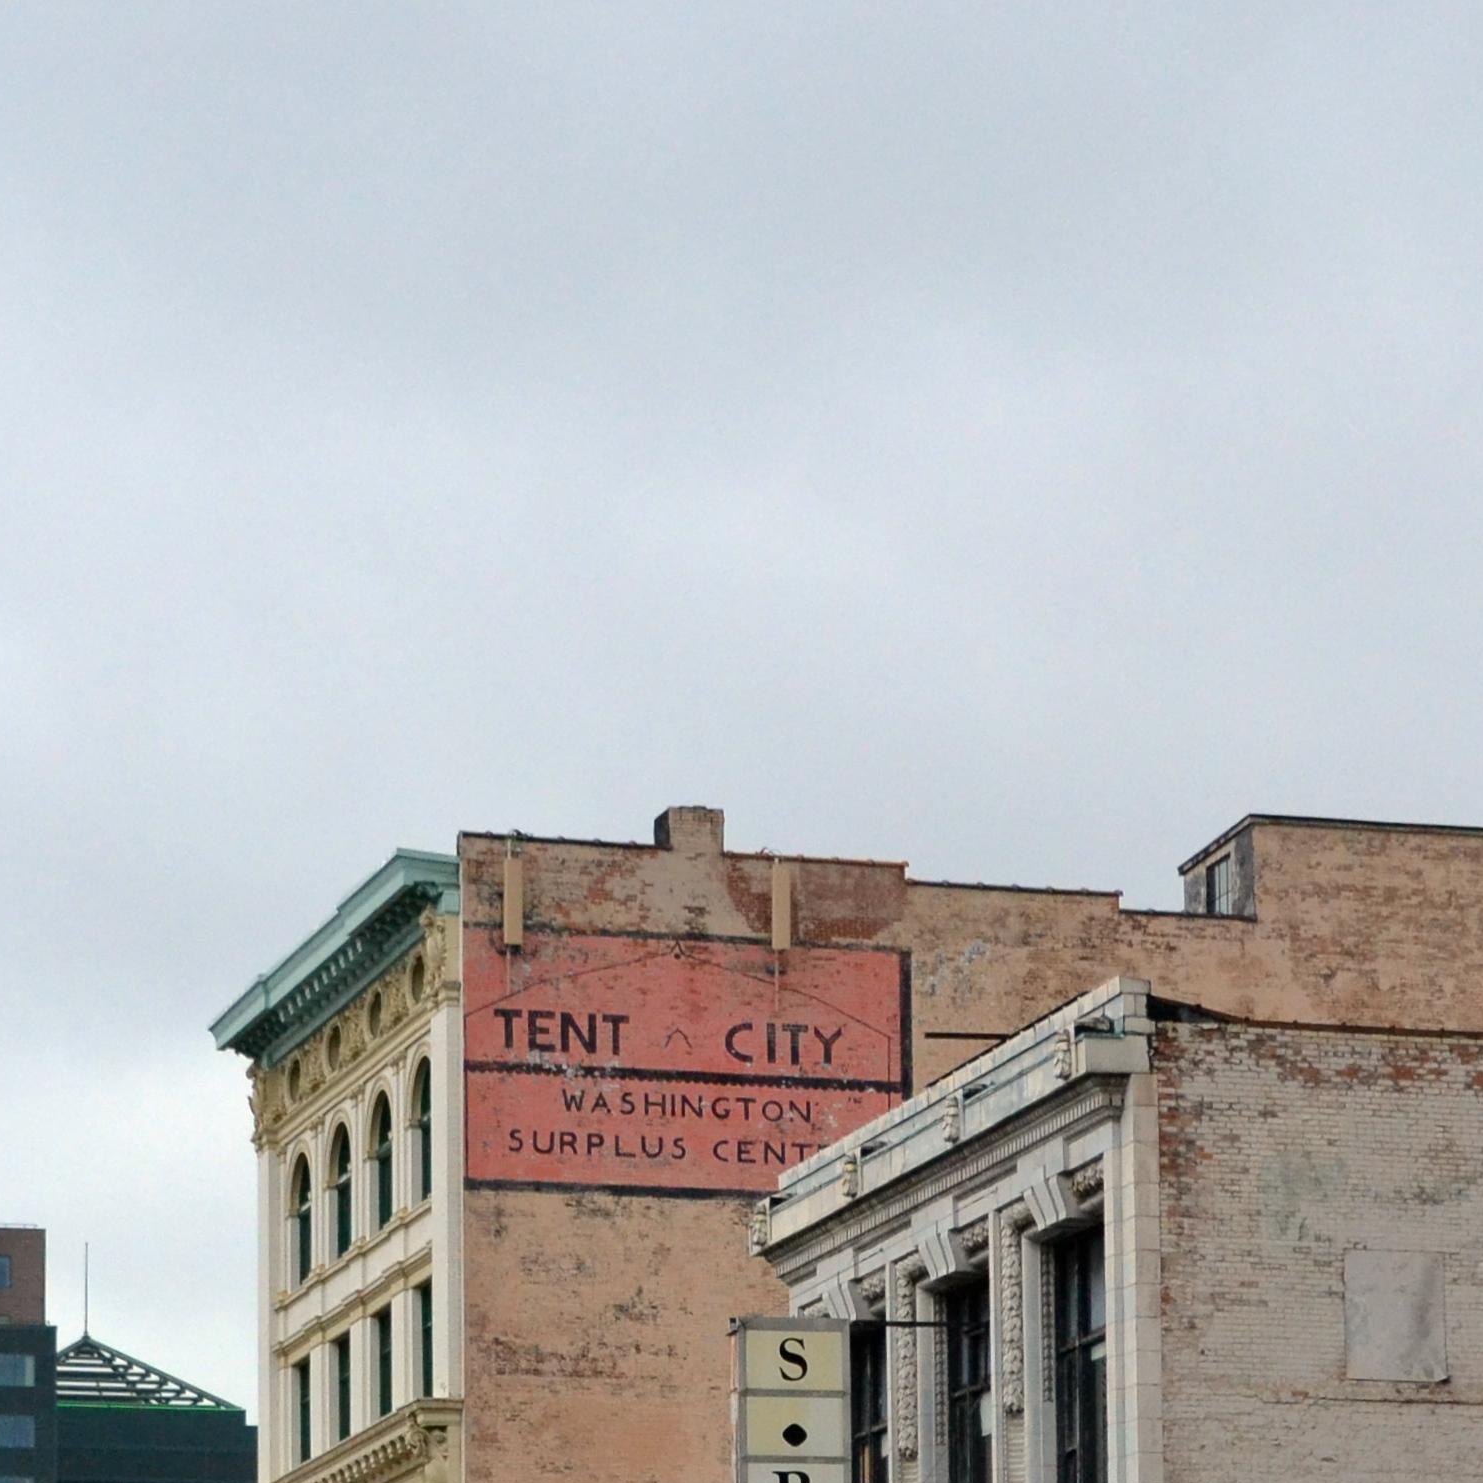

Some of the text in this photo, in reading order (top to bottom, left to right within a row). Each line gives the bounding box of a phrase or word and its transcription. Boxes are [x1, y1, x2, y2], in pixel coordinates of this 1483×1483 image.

[493, 1007, 843, 1067] TENT CITY
[561, 1087, 814, 1124] WASHINGTON
[508, 1128, 831, 1166] SURPLUS CENT
